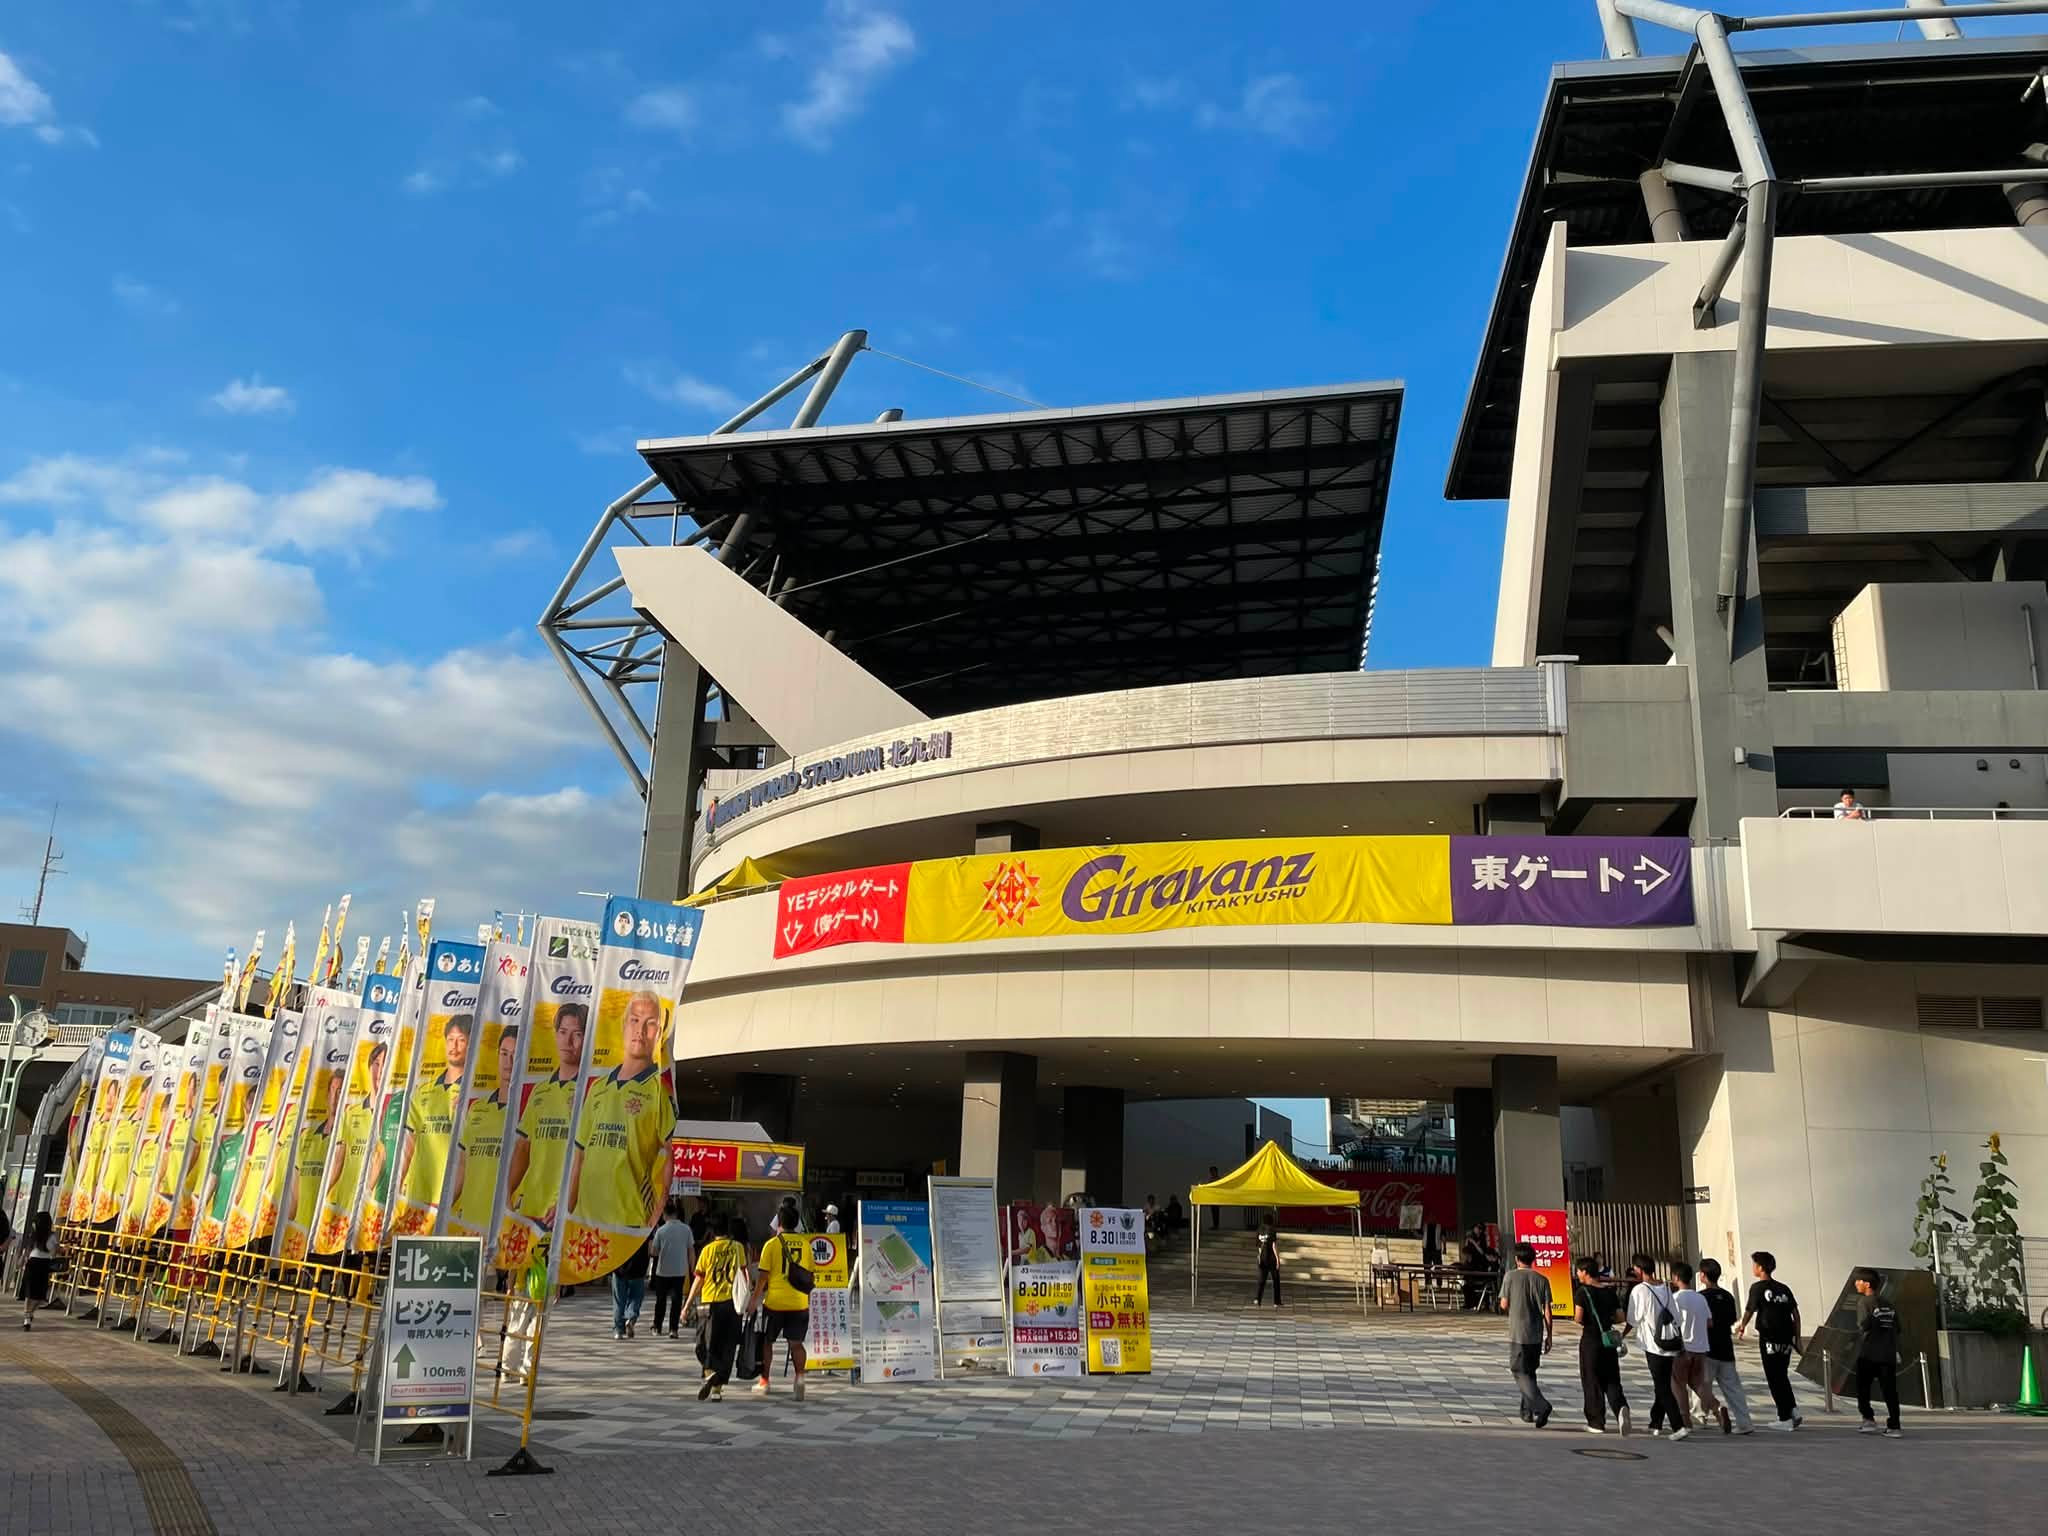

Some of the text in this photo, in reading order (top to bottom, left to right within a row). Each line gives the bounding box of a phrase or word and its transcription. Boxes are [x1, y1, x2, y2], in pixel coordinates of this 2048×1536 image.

[801, 747, 884, 789] STADIUM
[887, 731, 952, 768] 北九州
[1061, 852, 1316, 922] Giravanz
[1471, 855, 1625, 893] 東ゲート
[1186, 886, 1307, 914] KITAKYUSHU
[1090, 1230, 1115, 1245] 8.30
[398, 1248, 474, 1283] 北ゲート
[1019, 1282, 1047, 1297] 8.30
[1097, 1293, 1135, 1309] 小中高
[395, 1299, 472, 1325] ビジター
[1055, 1331, 1078, 1340] 15:30
